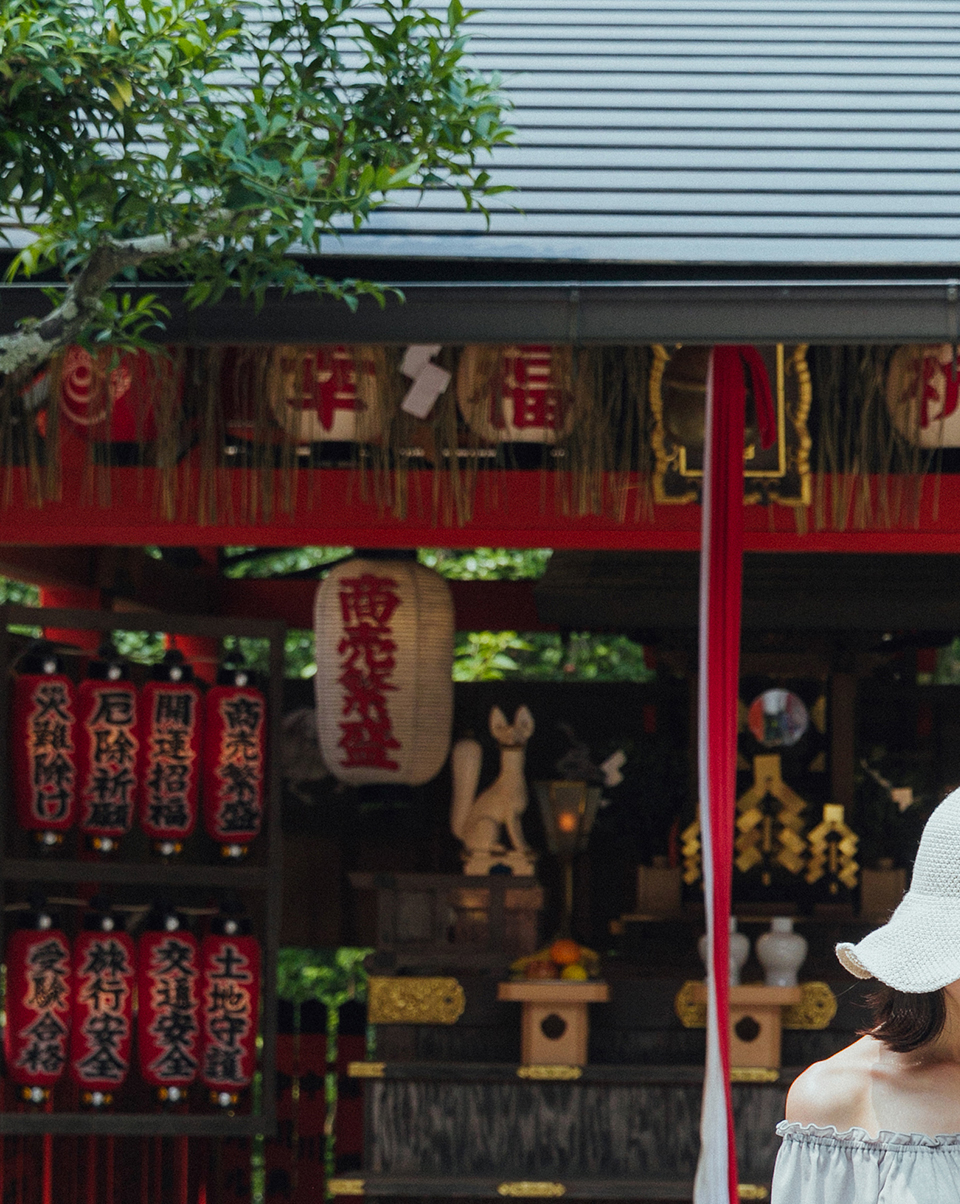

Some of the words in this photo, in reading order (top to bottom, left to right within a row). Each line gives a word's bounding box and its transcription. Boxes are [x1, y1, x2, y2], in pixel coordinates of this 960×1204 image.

[337, 573, 402, 772] 商売繁盛
[31, 685, 73, 821] 災難除け
[88, 691, 134, 829] 厄除祈願
[147, 692, 195, 829] 開運招福
[219, 696, 261, 833] 商売繁盛
[79, 940, 129, 1079] 旅行安全
[151, 940, 197, 1078] 交通安全
[204, 946, 249, 1081] 土地守護
